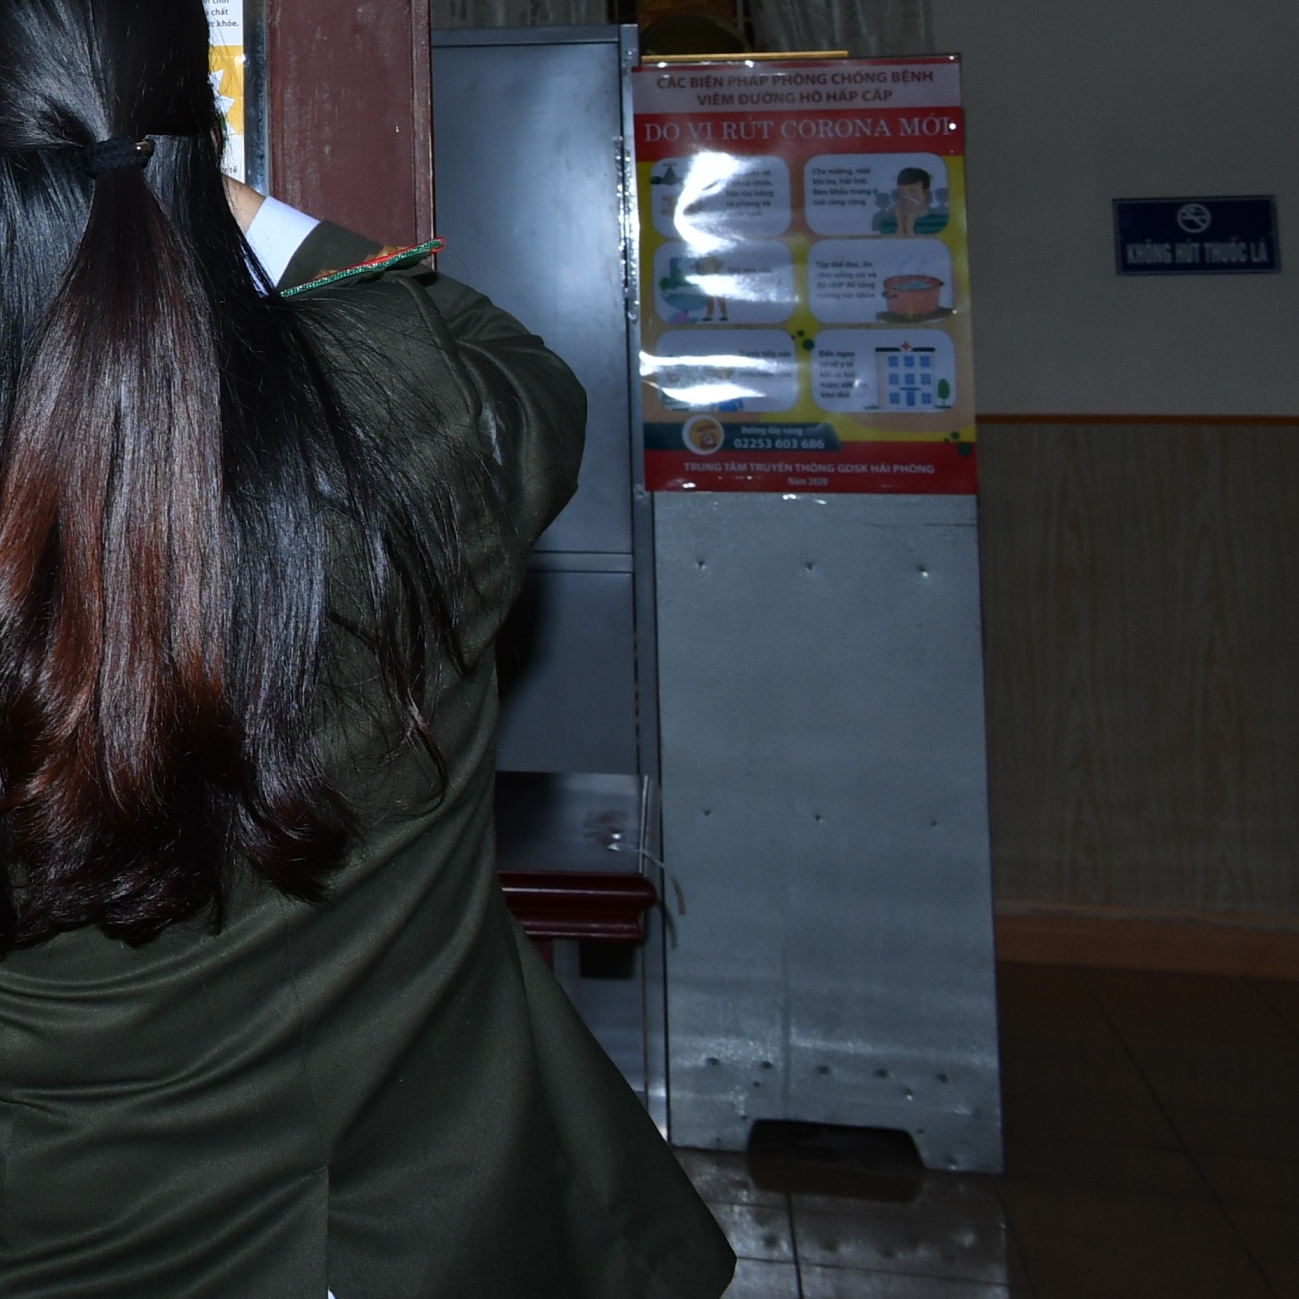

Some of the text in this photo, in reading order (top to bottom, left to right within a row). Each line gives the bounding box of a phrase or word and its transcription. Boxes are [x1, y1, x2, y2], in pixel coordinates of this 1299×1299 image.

[644, 123, 680, 142] DO
[687, 122, 714, 141] VI
[721, 116, 774, 140] RÚT
[780, 119, 892, 139] CORONA
[1125, 238, 1172, 264] KHÔNG
[734, 438, 825, 449] 02253 603 686
[684, 462, 722, 472] TRUNG
[724, 461, 747, 472] TÂM
